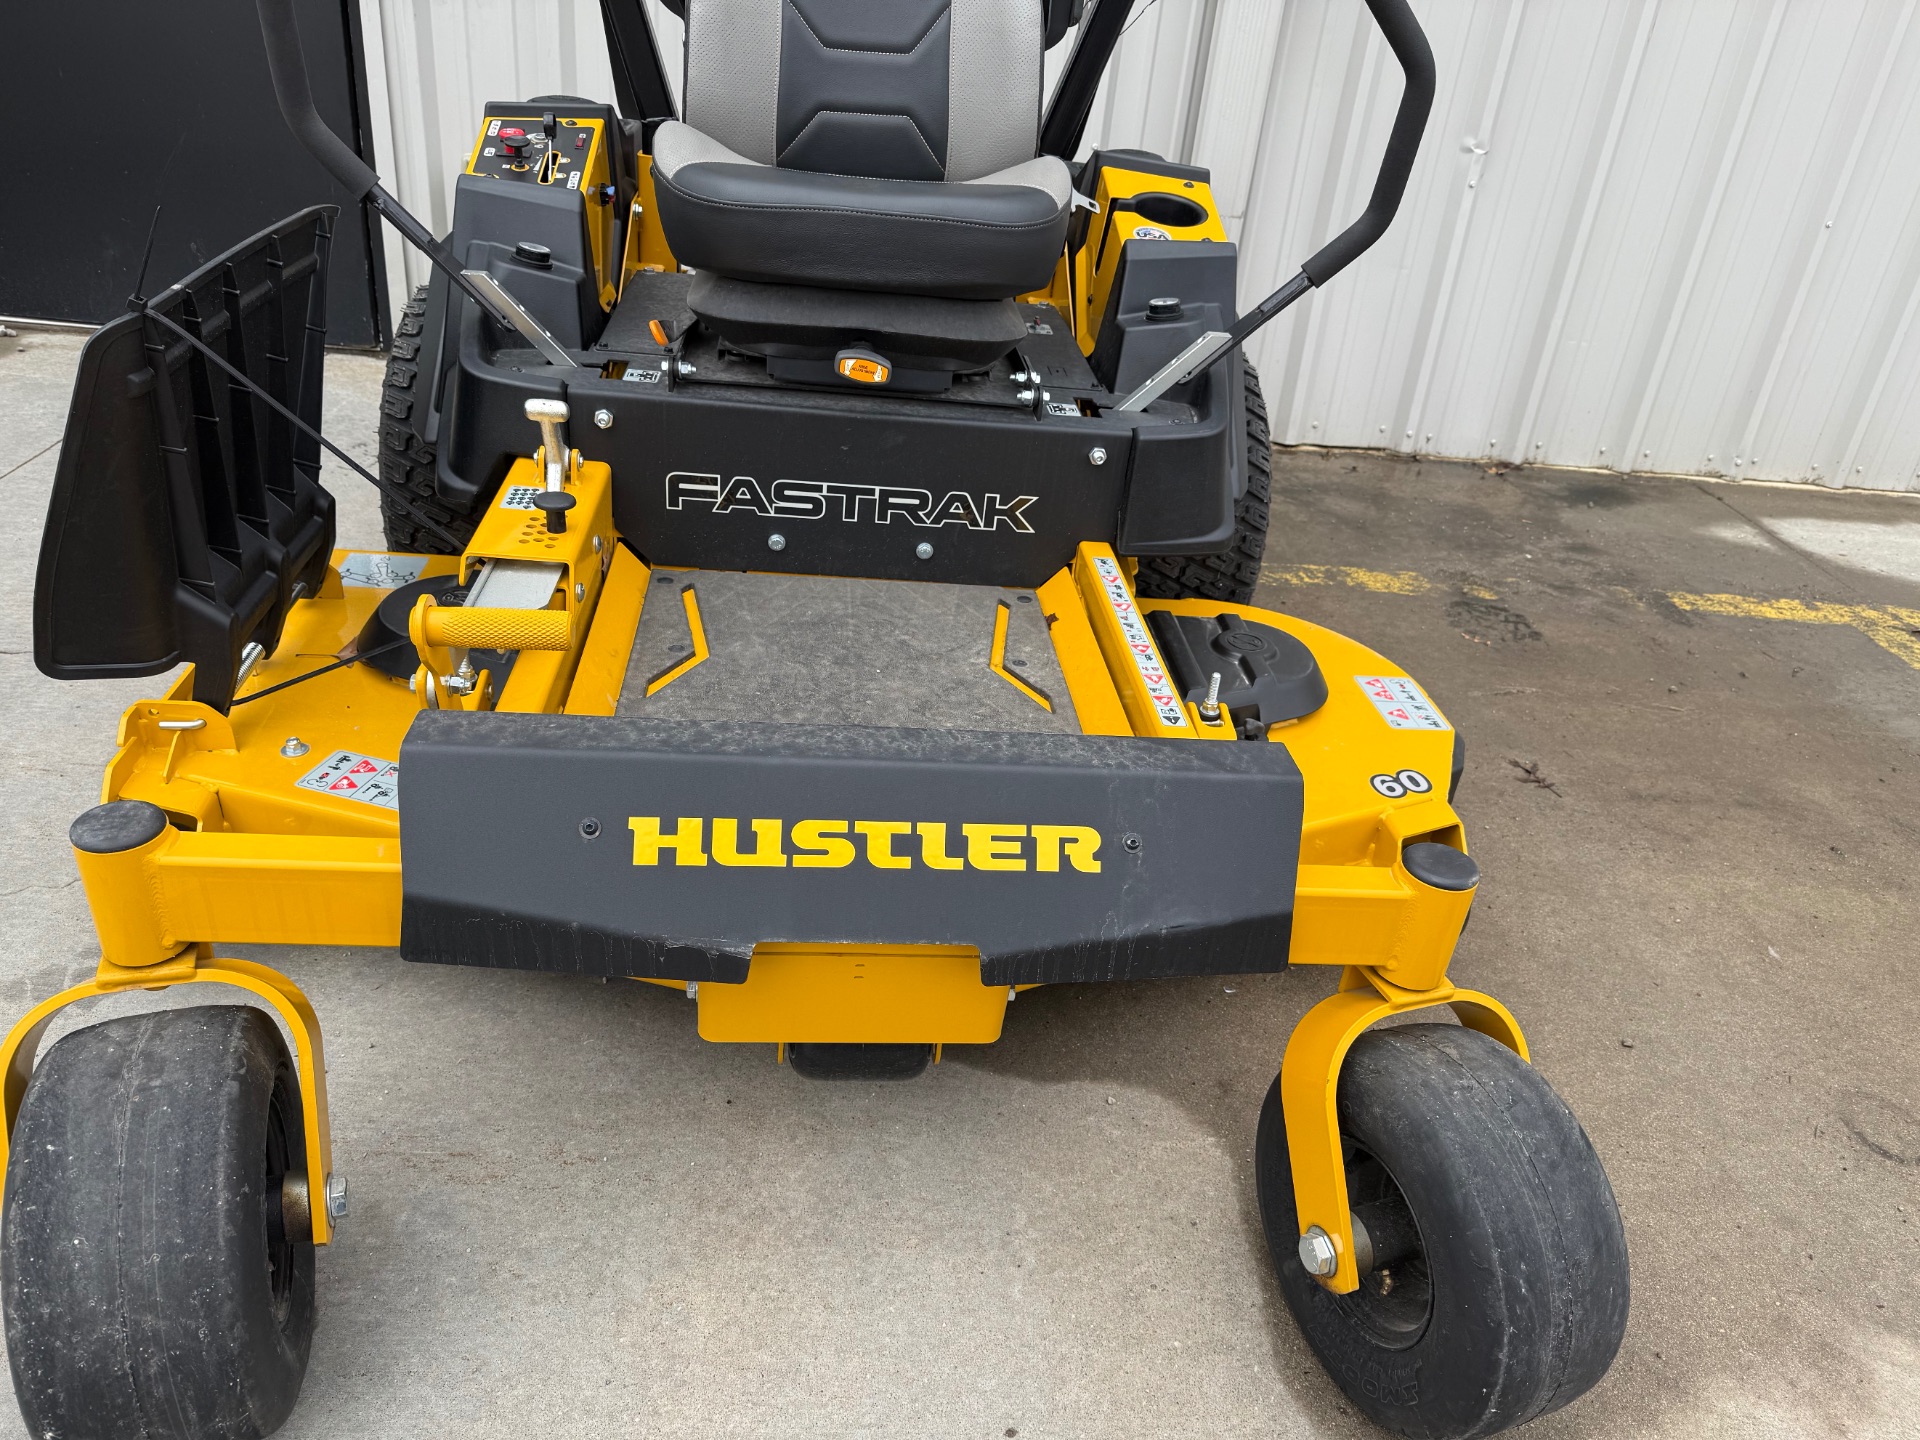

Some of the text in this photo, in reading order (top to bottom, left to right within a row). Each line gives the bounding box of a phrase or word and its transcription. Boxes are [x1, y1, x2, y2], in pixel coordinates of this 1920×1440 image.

[666, 472, 1039, 533] FASTRAK
[1370, 769, 1432, 798] 60
[628, 816, 1101, 873] HUSTLER
